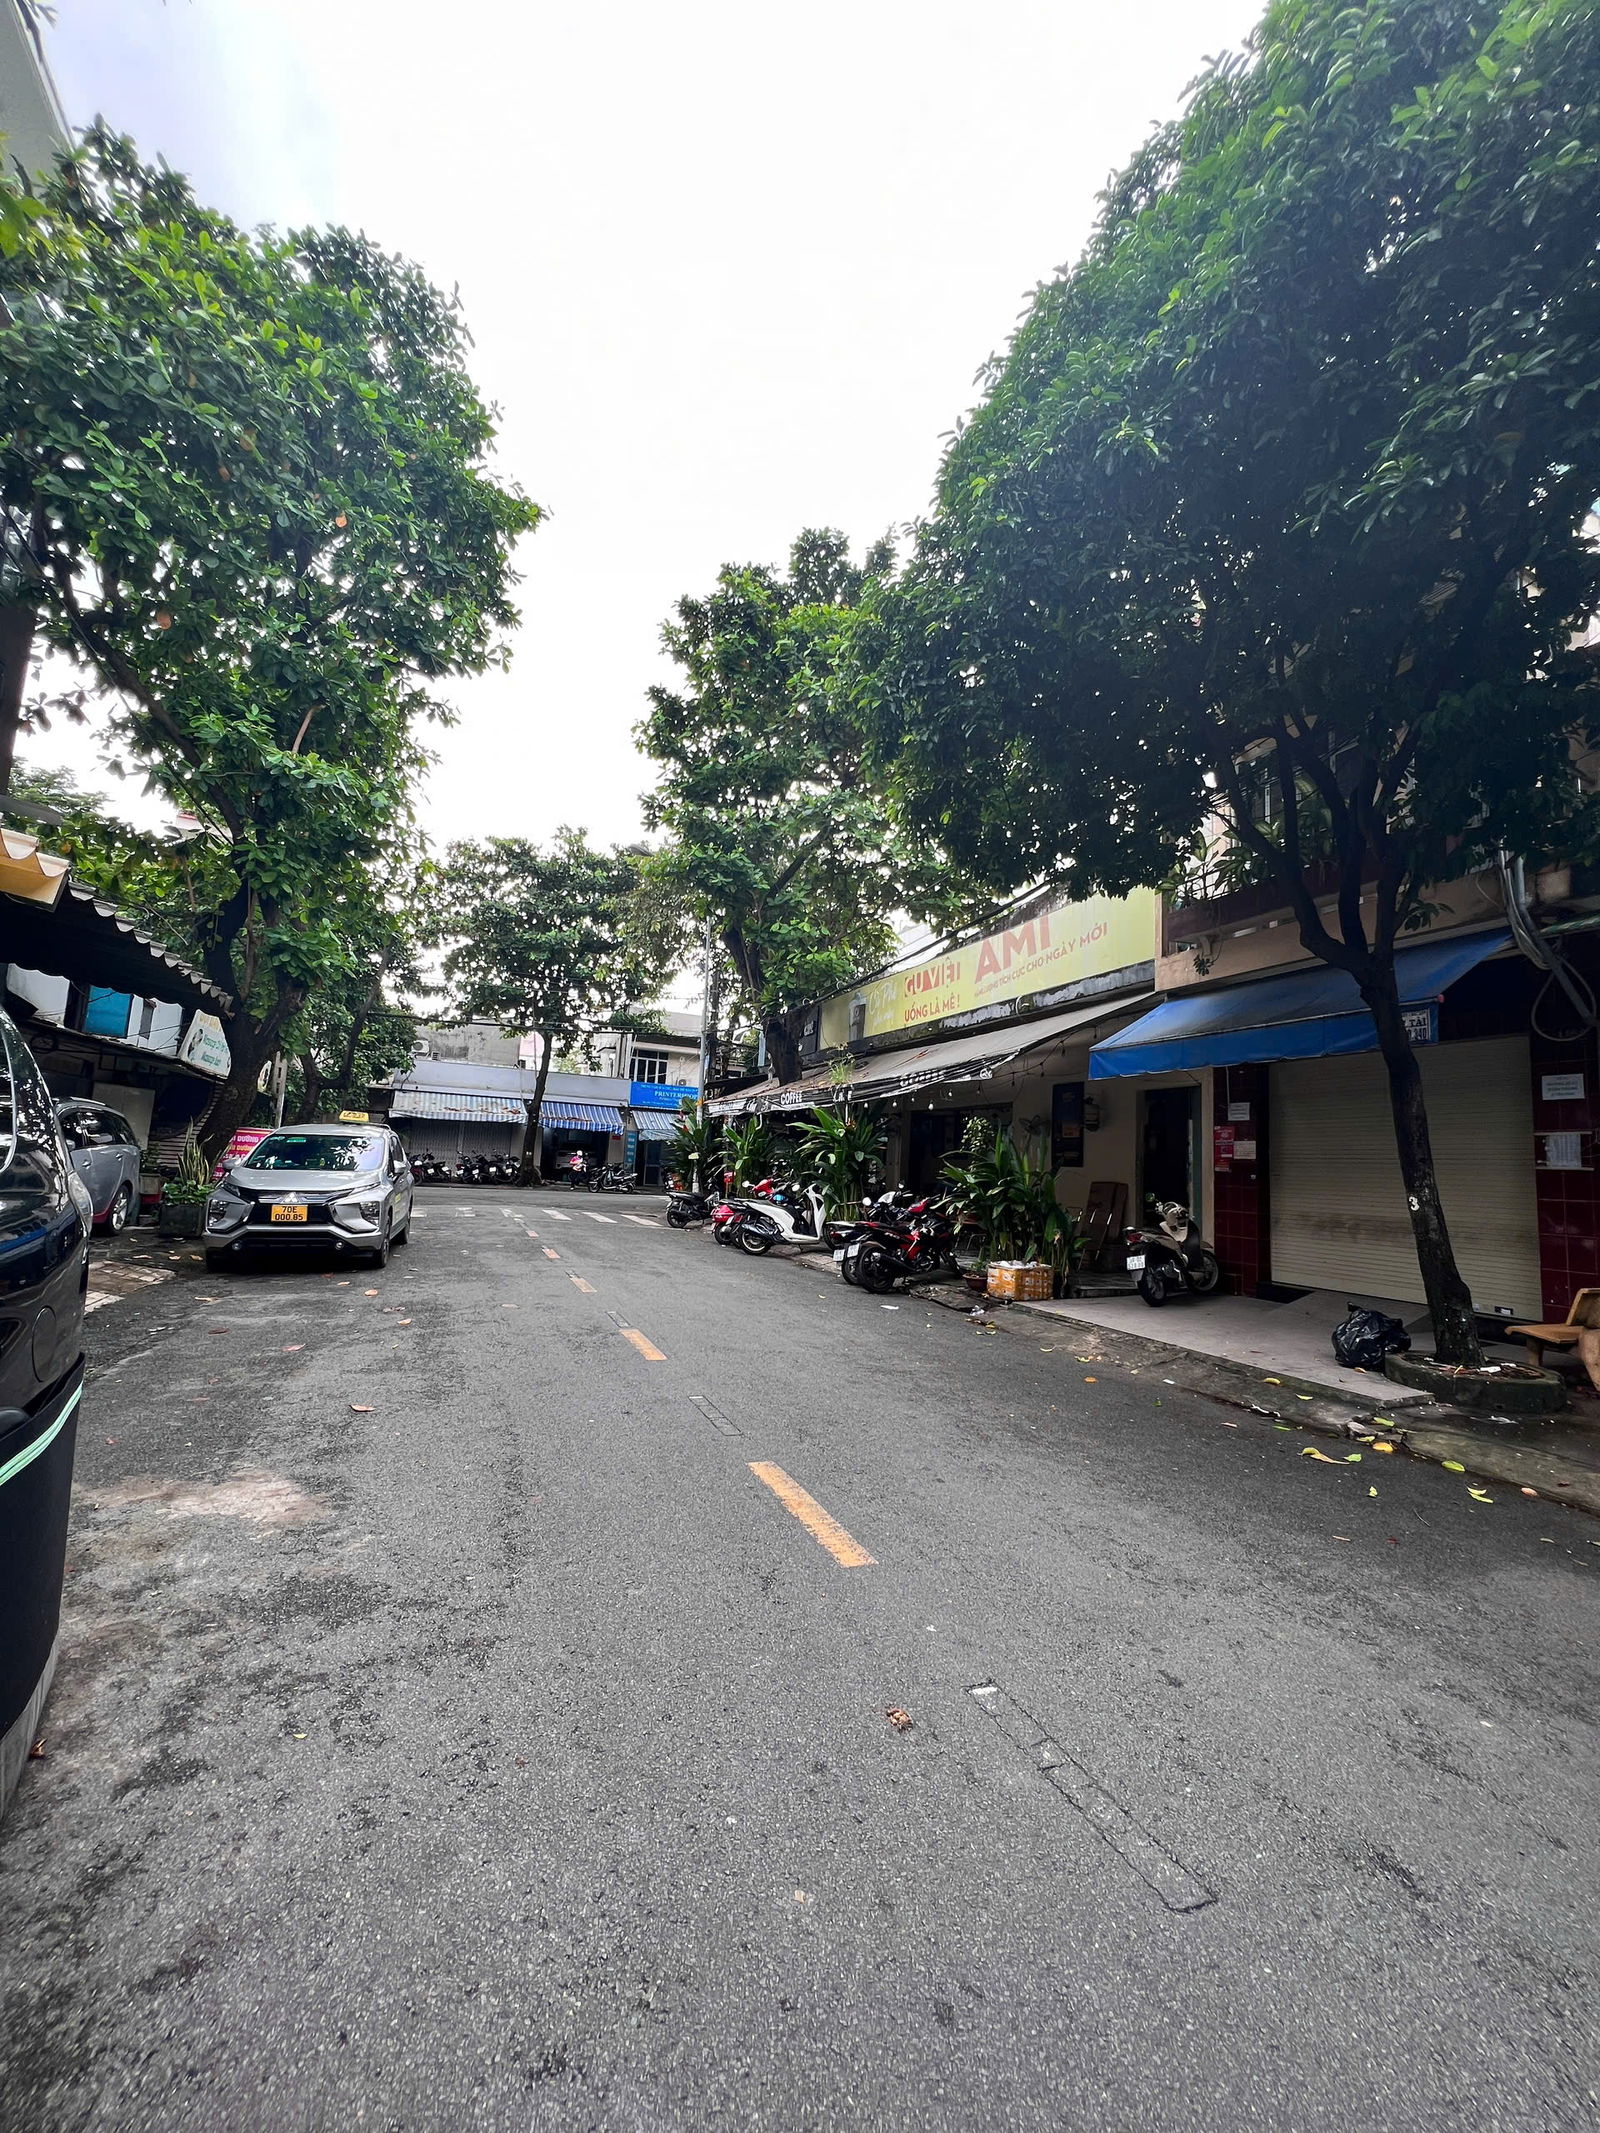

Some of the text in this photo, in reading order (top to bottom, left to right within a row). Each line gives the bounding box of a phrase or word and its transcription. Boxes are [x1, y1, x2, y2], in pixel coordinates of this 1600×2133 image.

[975, 915, 1051, 984] AMI
[1026, 957, 1044, 972] CHO
[1045, 940, 1076, 964] NGÀY
[1080, 922, 1108, 948] MỚI
[904, 1001, 928, 1022] UỐNG
[929, 996, 941, 1015] LÀ
[942, 992, 955, 1012] MÊ
[780, 1091, 802, 1105] COFFEE
[1409, 1196, 1420, 1210] 3
[275, 1213, 304, 1221] 000.85
